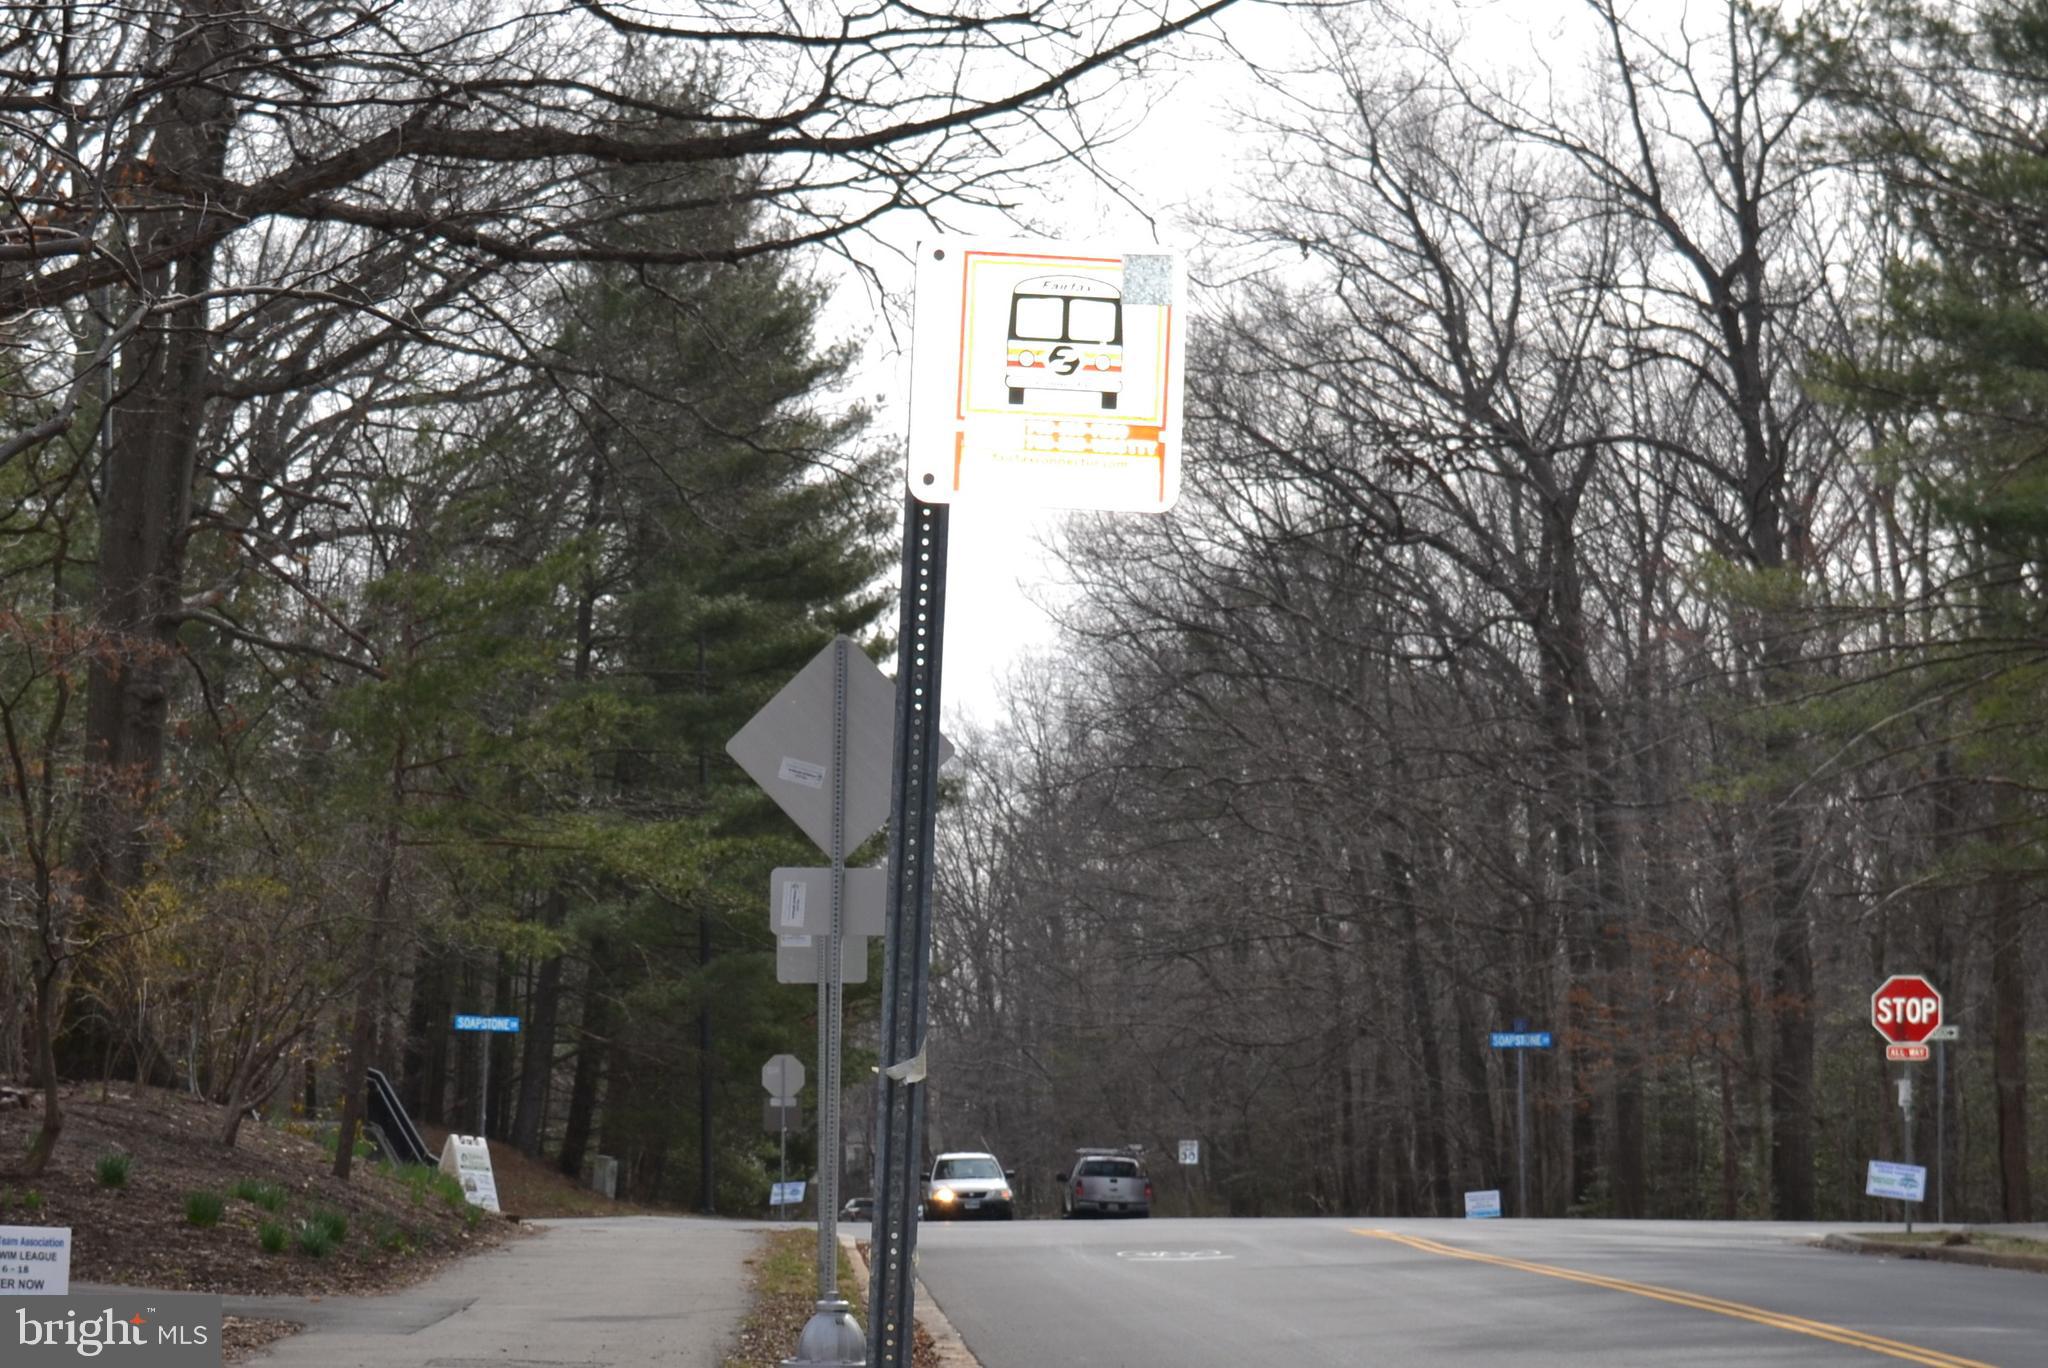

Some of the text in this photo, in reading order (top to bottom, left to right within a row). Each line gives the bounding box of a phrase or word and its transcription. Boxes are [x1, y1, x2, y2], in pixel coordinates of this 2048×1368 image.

[1877, 997, 1936, 1024] STOP
[458, 1016, 511, 1031] SOAPSTONE
[1890, 1048, 1925, 1057] ALL WAY
[20, 1237, 65, 1247] Association
[19, 1251, 57, 1262] LEAGUE
[2, 1264, 8, 1273] 6
[18, 1265, 29, 1274] 18
[18, 1279, 45, 1290] NOW
